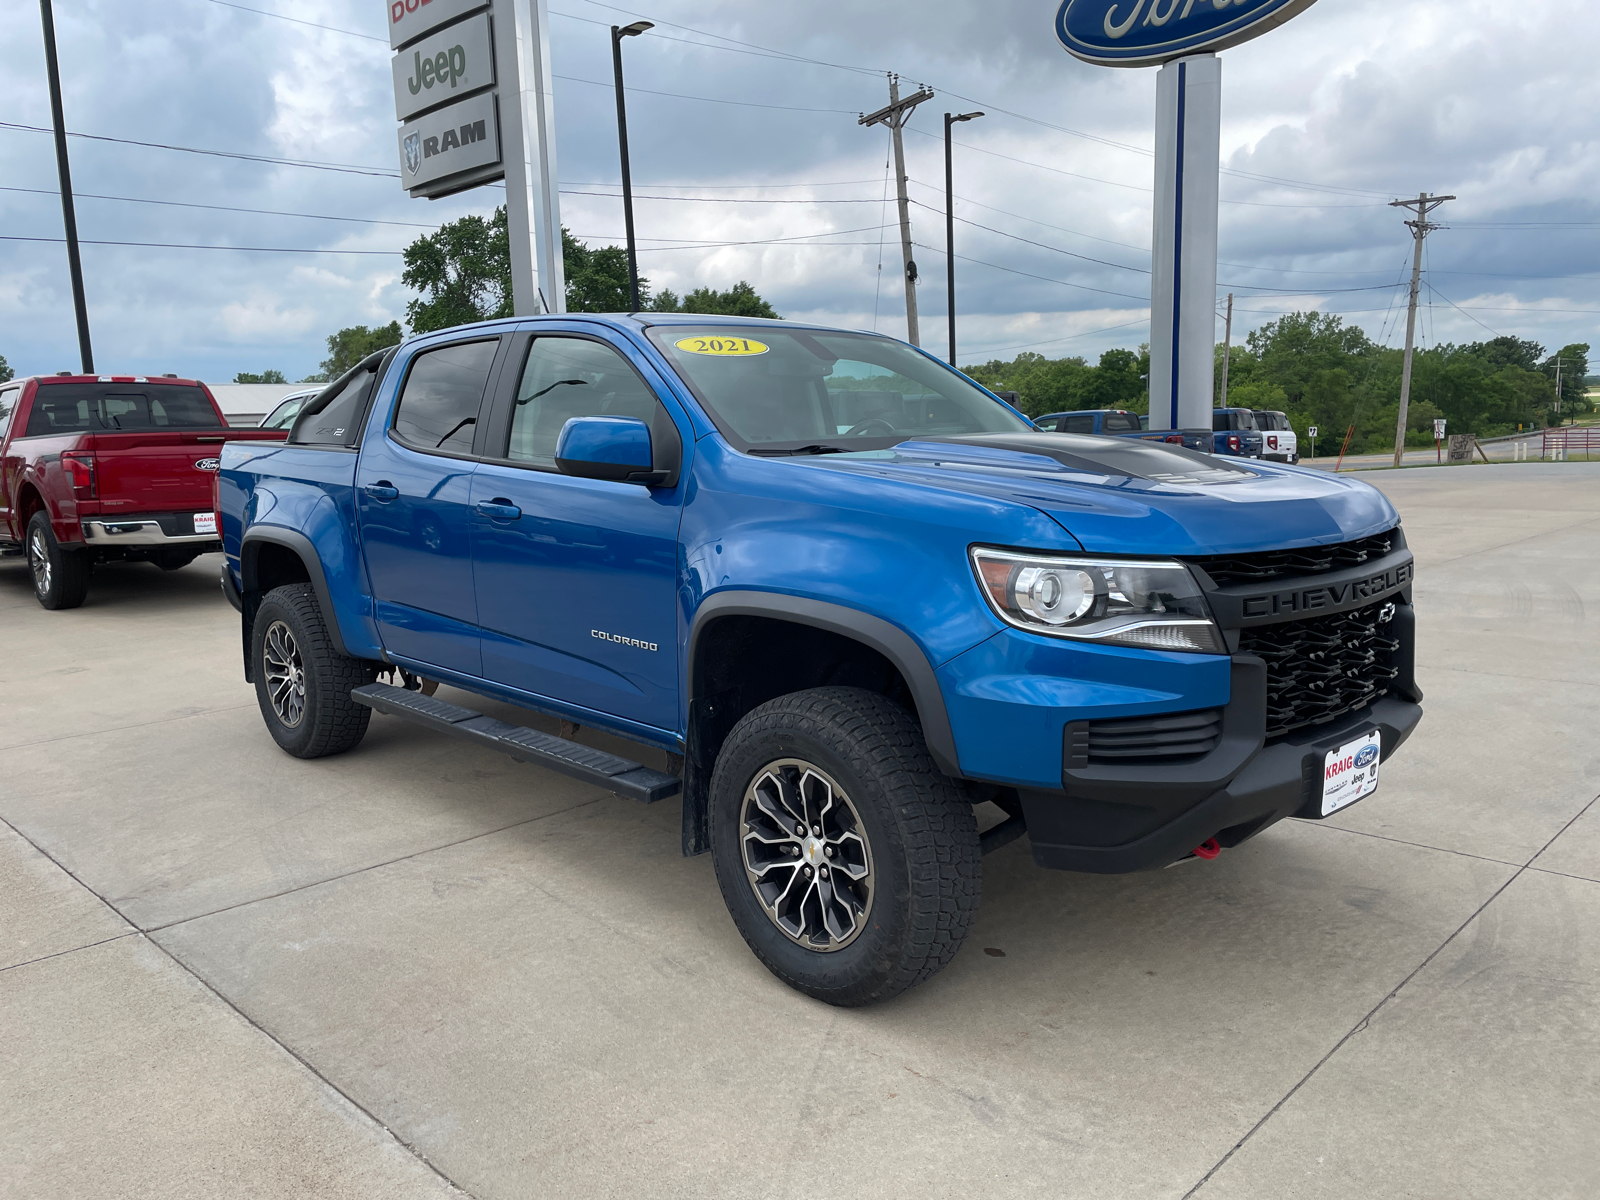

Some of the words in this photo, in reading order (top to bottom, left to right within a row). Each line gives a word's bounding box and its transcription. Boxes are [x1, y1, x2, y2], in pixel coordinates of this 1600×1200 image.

[407, 44, 466, 95] Jeep
[423, 119, 487, 159] RAM
[693, 339, 753, 352] 2021
[1242, 562, 1413, 619] CHEVROLET
[591, 629, 658, 652] COLORADO
[1325, 755, 1353, 780] KRAIG
[1357, 748, 1374, 766] Ford
[1351, 772, 1365, 786] Jeep
